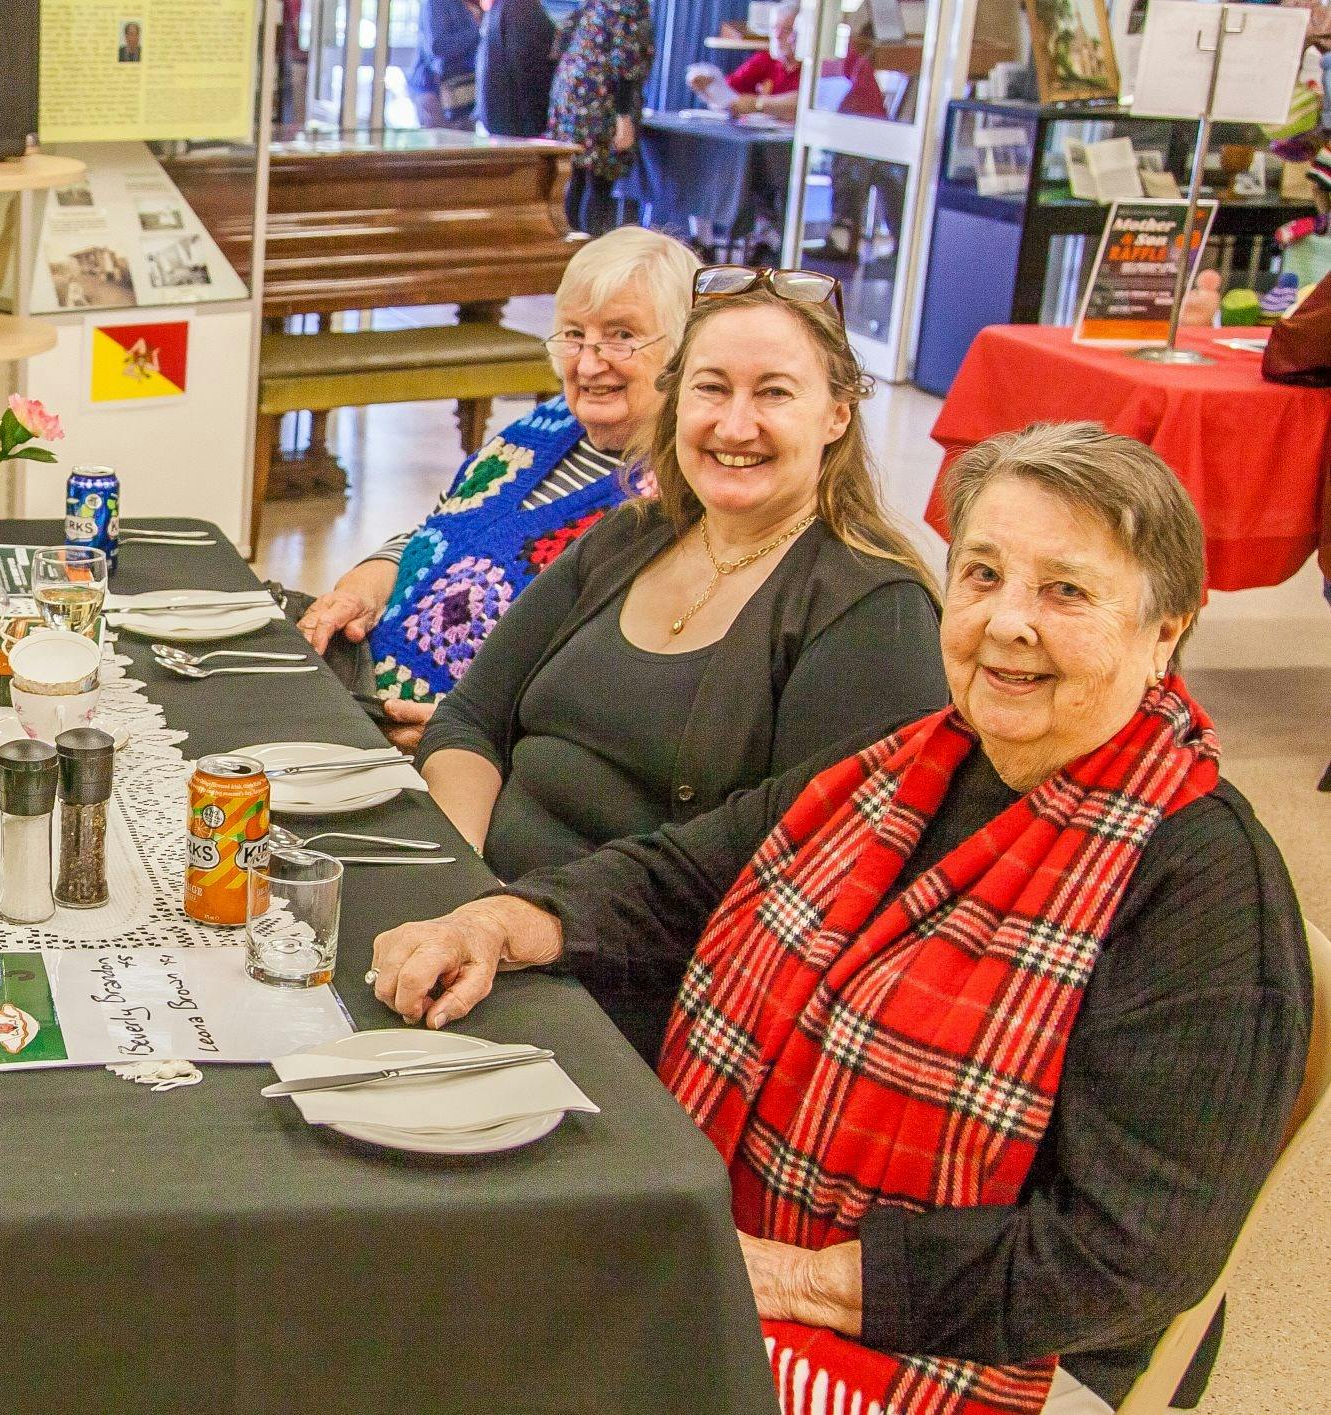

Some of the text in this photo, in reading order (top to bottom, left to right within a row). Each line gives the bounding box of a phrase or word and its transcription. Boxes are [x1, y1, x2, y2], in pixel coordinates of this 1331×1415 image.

[1107, 245, 1167, 261] RAFFLE
[90, 956, 126, 1003] Brandon
[166, 972, 199, 1010] Brown
[109, 1006, 155, 1056] Beverly
[188, 1016, 219, 1052] Leona
